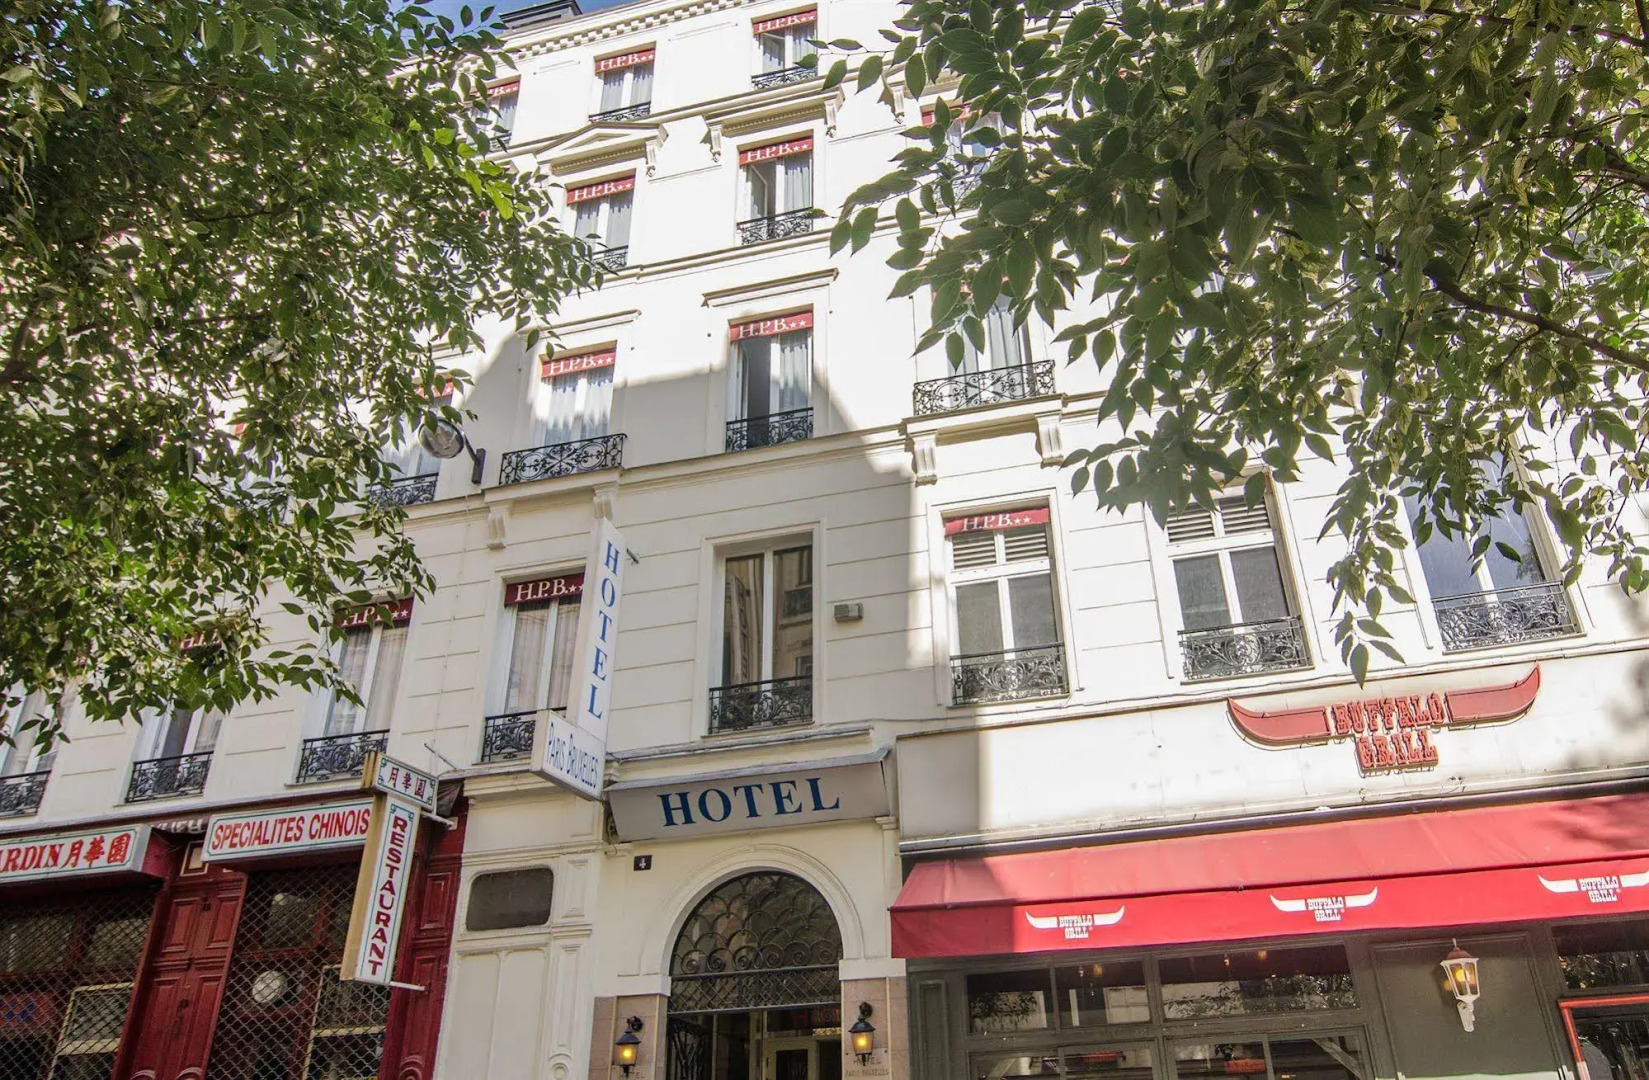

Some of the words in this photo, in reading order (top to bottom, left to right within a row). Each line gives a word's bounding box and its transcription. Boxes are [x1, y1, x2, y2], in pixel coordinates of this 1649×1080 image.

[587, 540, 620, 720] HOTEL
[1331, 692, 1445, 735] BUFFALO
[1355, 729, 1438, 769] GRILL
[388, 767, 427, 799] 月華園
[657, 777, 840, 827] HOTEL
[211, 816, 305, 851] SPECIALITES
[308, 808, 371, 840] CHINOIS
[62, 832, 132, 869] 月華園
[368, 815, 408, 976] RESTAURANT
[1578, 876, 1619, 891] BUFFALO
[1587, 889, 1618, 903] GRILL
[1058, 914, 1093, 928] BUFFALO
[1306, 897, 1344, 911] BUFFALO
[1314, 908, 1341, 922] GRILL
[1064, 927, 1089, 939] GRILL
